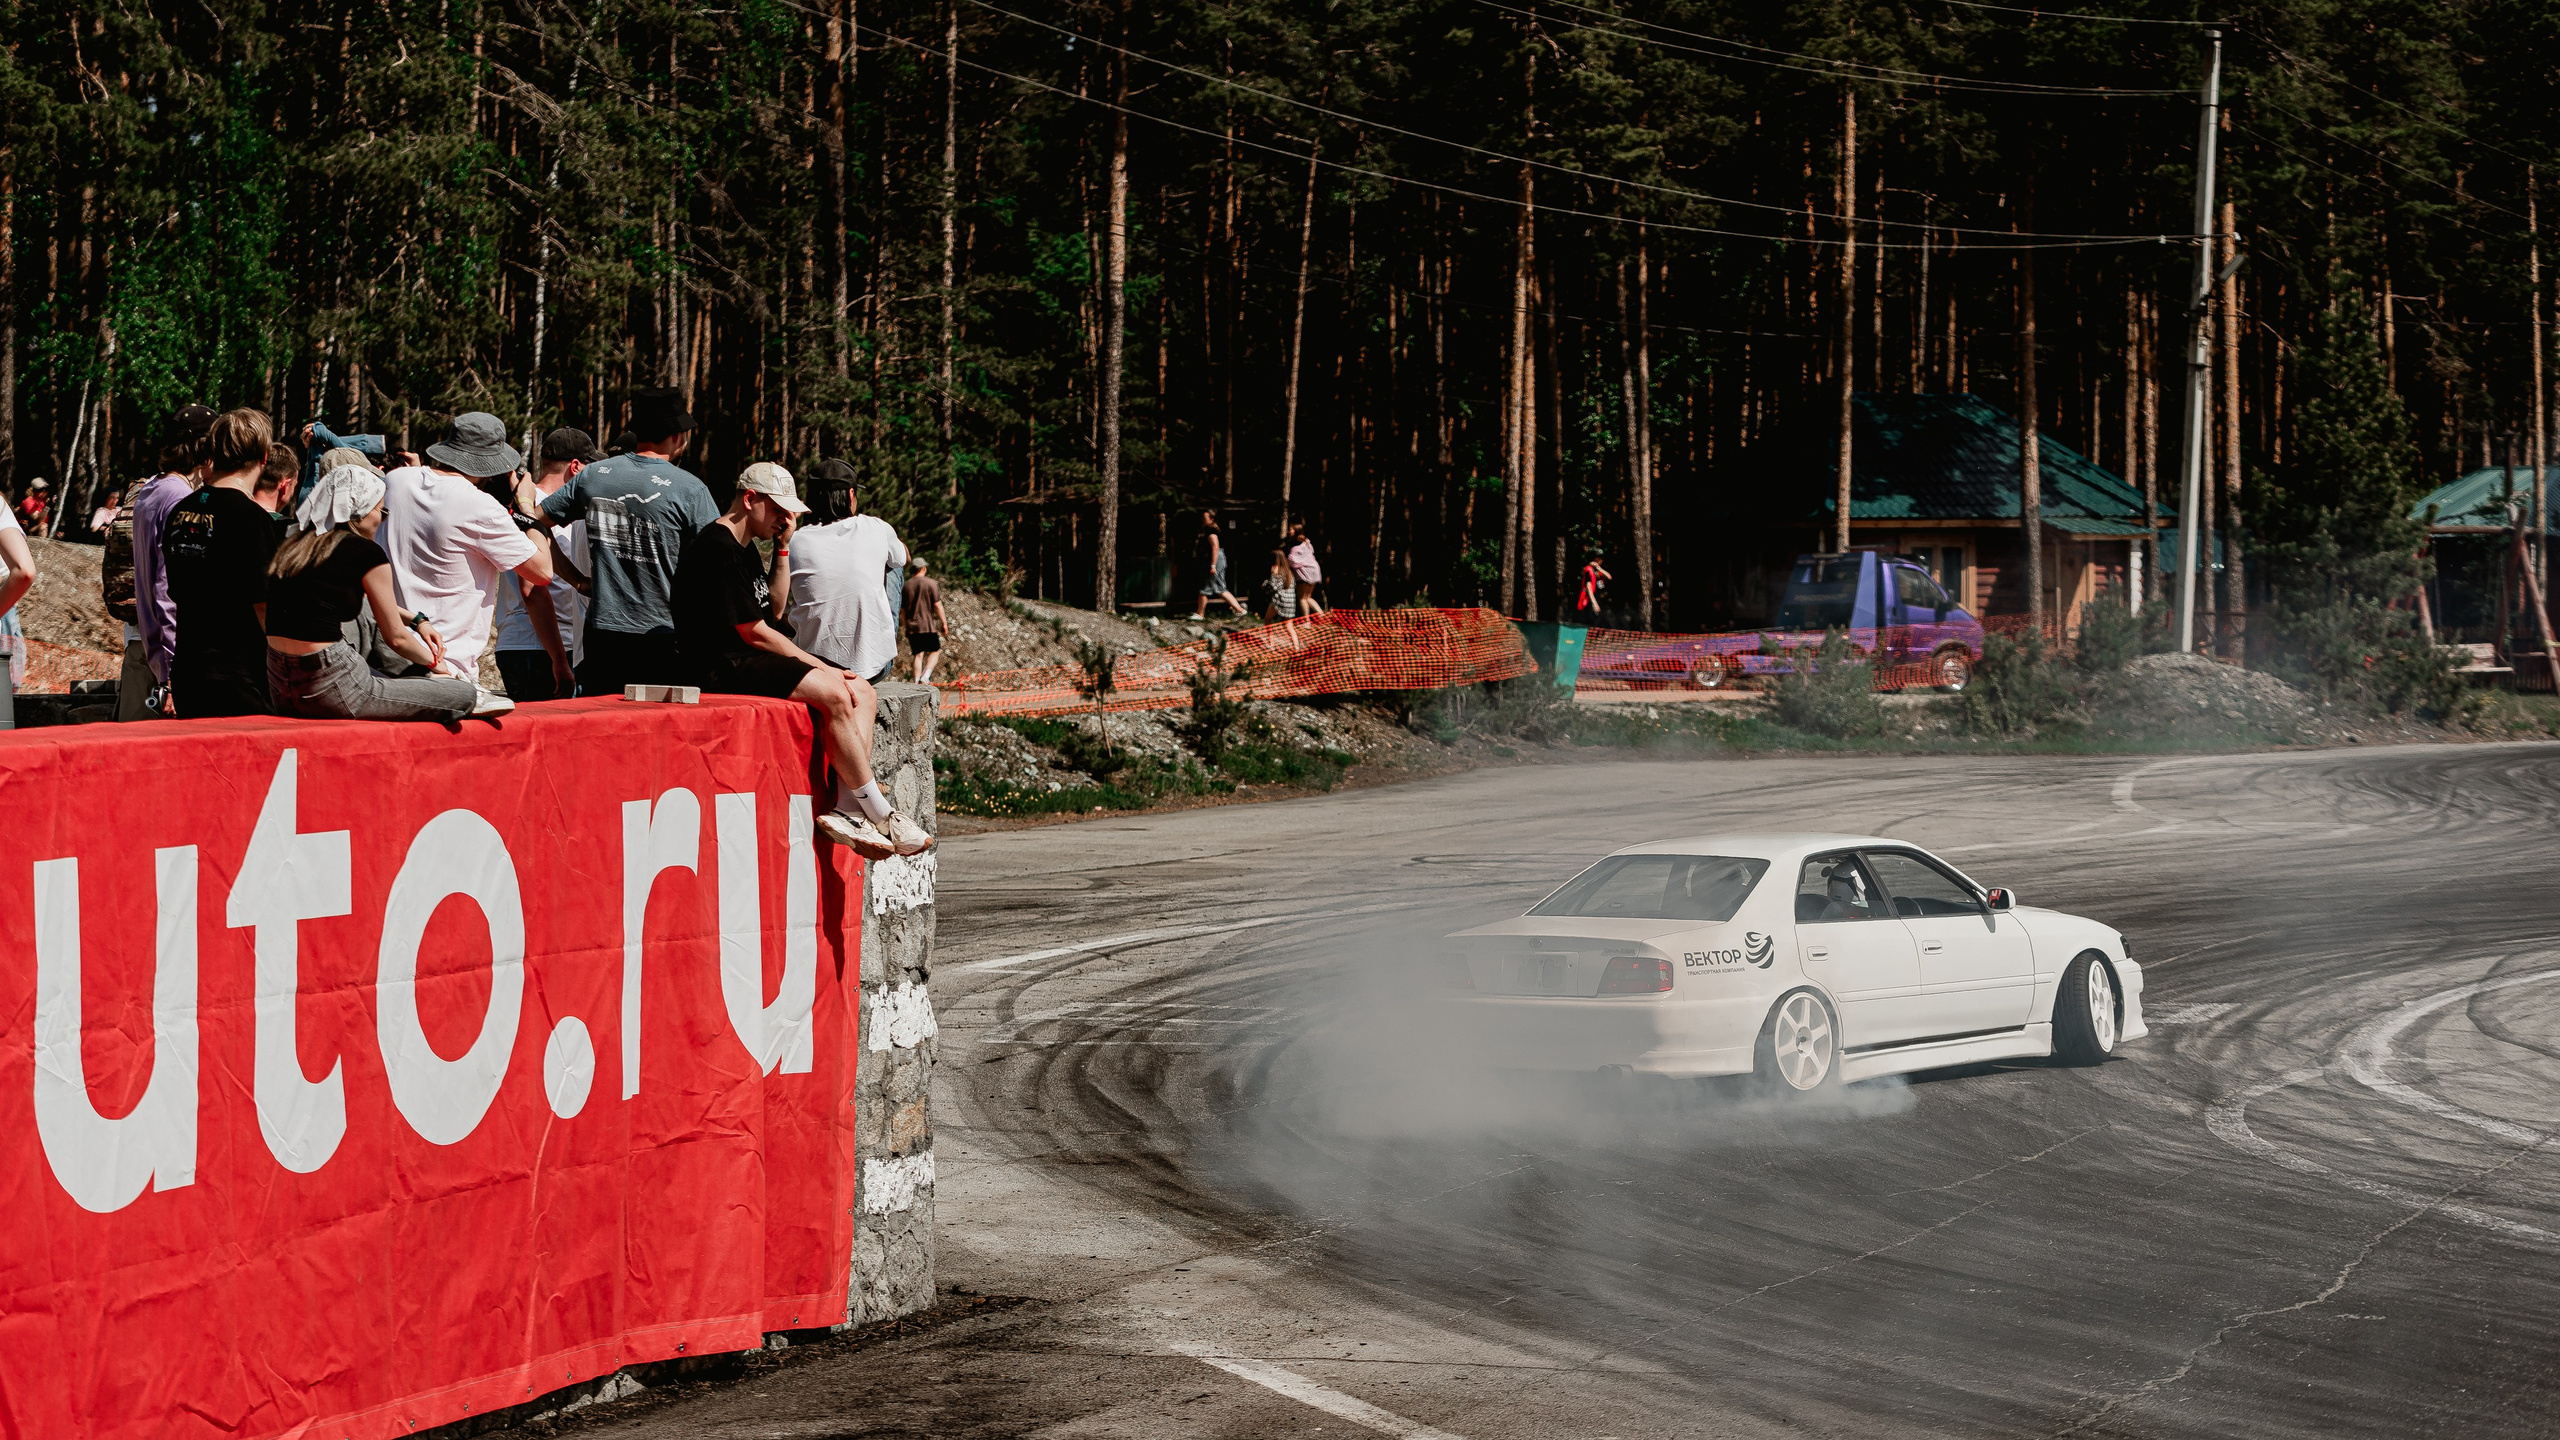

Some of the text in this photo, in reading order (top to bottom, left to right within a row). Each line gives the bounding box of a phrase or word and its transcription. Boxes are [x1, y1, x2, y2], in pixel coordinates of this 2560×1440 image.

[513, 511, 535, 525] SONY
[1683, 949, 1742, 968] ВЕКТОР
[34, 749, 816, 1214] uto.ru
